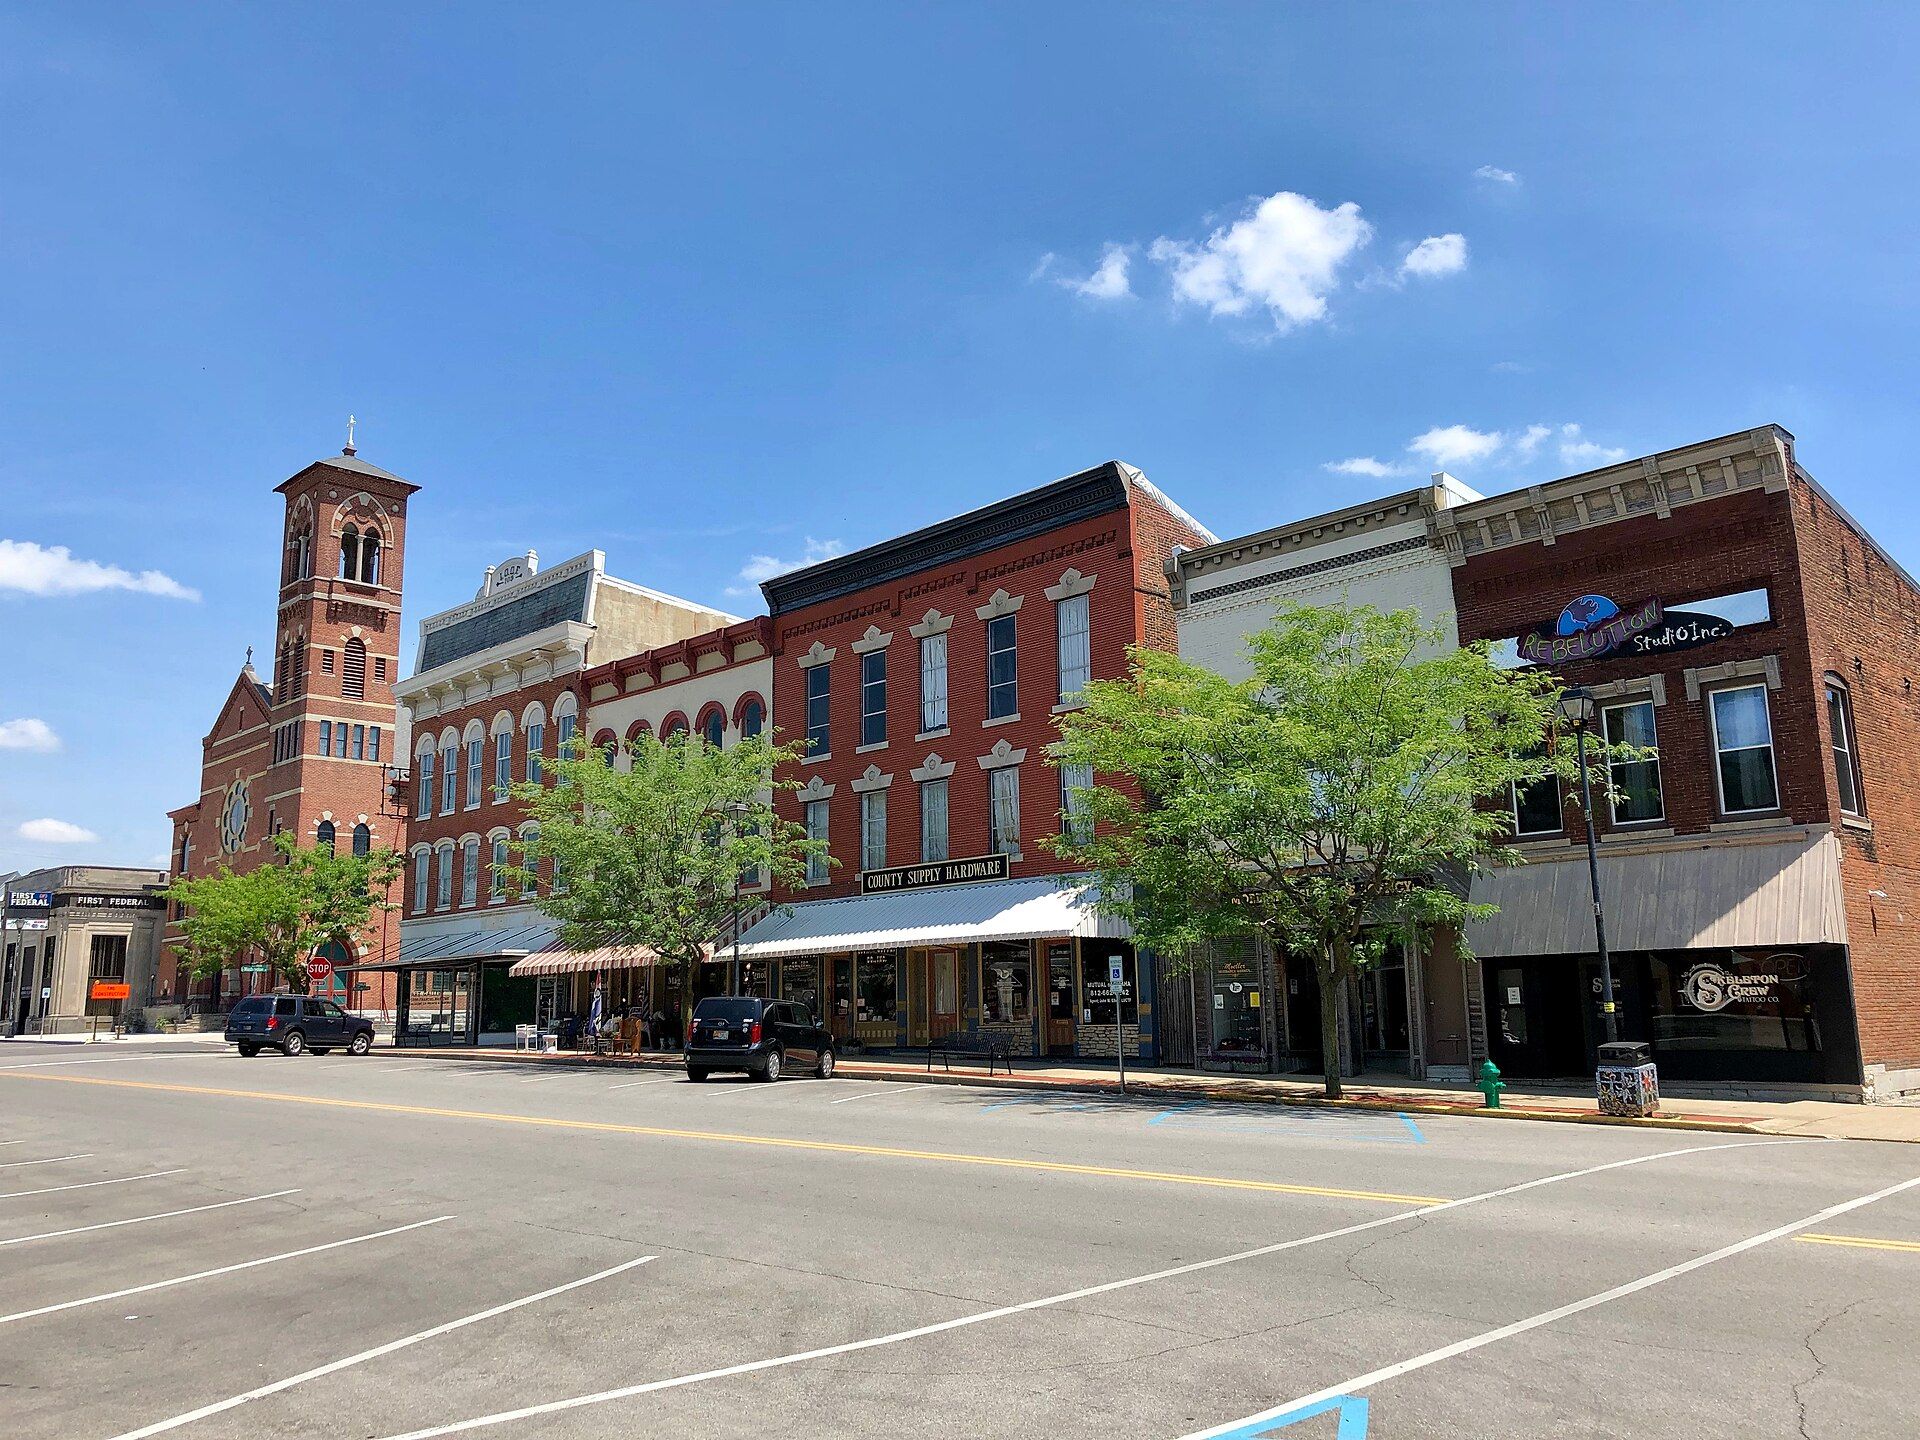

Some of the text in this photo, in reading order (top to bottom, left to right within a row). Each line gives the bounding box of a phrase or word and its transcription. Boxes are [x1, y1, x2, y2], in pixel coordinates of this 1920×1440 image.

[1521, 600, 1657, 661] REBELUTION
[867, 860, 1001, 889] COUNTY SUPPLY HARDWARE
[10, 898, 49, 906] FEDERAL
[78, 896, 150, 906] FIRST FEDERAL
[309, 964, 329, 973] STOP
[1698, 970, 1779, 1005] SKELETON
[1728, 984, 1769, 999] CREW
